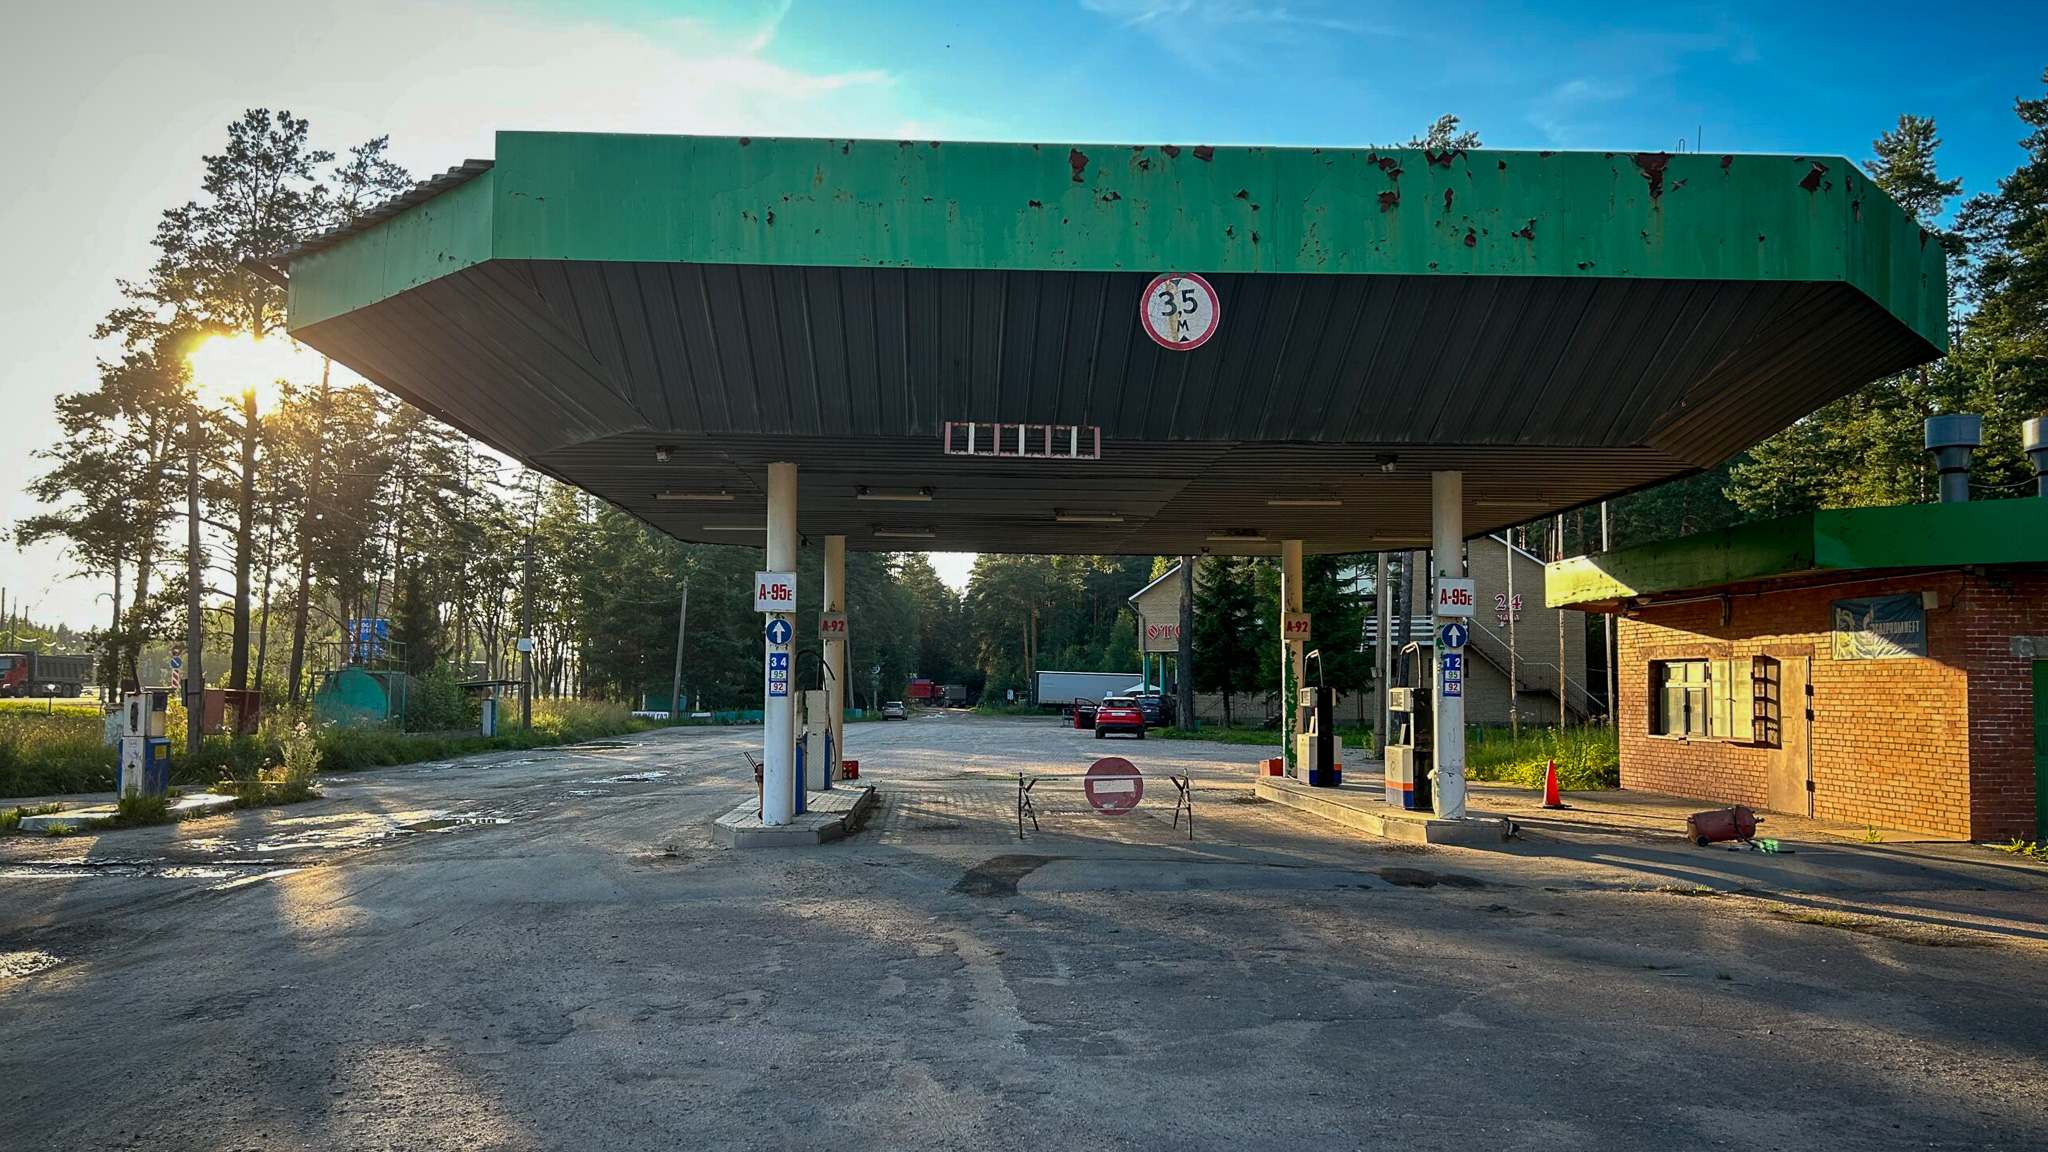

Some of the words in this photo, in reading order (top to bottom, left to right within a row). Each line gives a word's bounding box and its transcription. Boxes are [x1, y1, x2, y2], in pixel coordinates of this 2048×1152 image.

[1159, 289, 1198, 317] 3,5
[1177, 320, 1189, 332] М
[1494, 593, 1522, 611] 24
[822, 620, 845, 632] А-92
[1286, 621, 1308, 632] А-92
[771, 657, 777, 667] 3
[780, 657, 787, 667] 4
[1444, 658, 1450, 667] 1
[1454, 658, 1460, 667] 2
[773, 670, 784, 679] 95
[1448, 670, 1458, 679] 95
[773, 683, 784, 691] 92
[1448, 683, 1458, 691] 92
